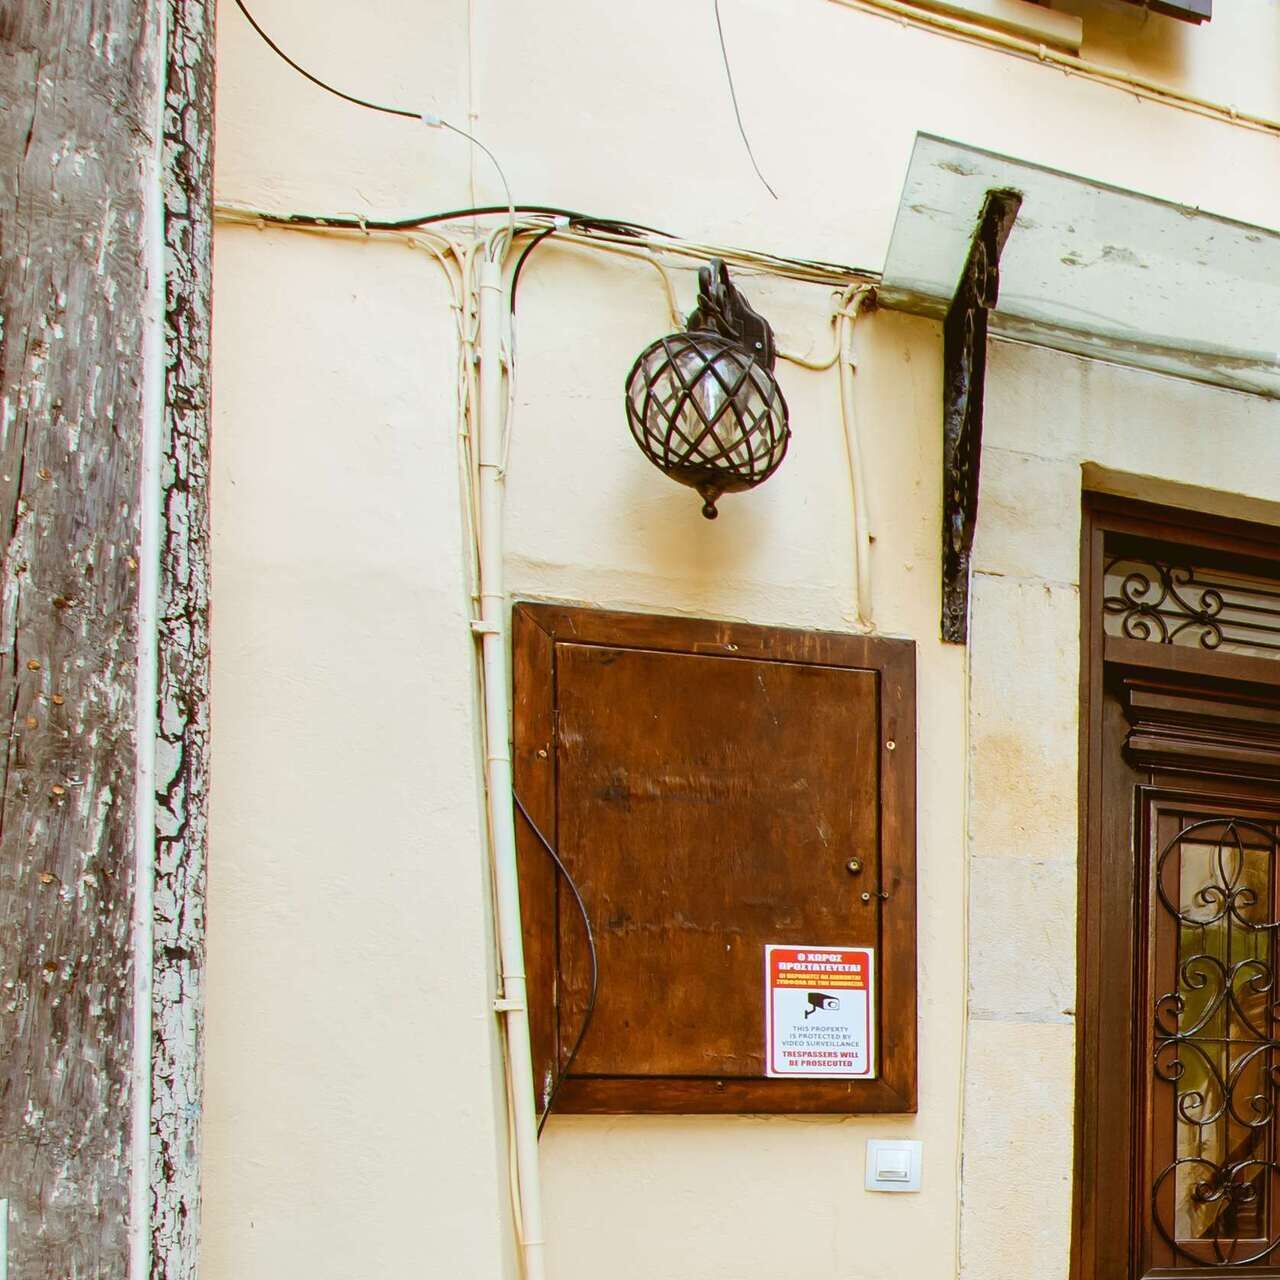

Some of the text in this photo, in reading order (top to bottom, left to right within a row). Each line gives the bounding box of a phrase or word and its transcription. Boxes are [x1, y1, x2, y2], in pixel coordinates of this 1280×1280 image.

[797, 953, 843, 962] Ο ΧΩΡΟΣ
[800, 1059, 853, 1067] PROSECUTED
